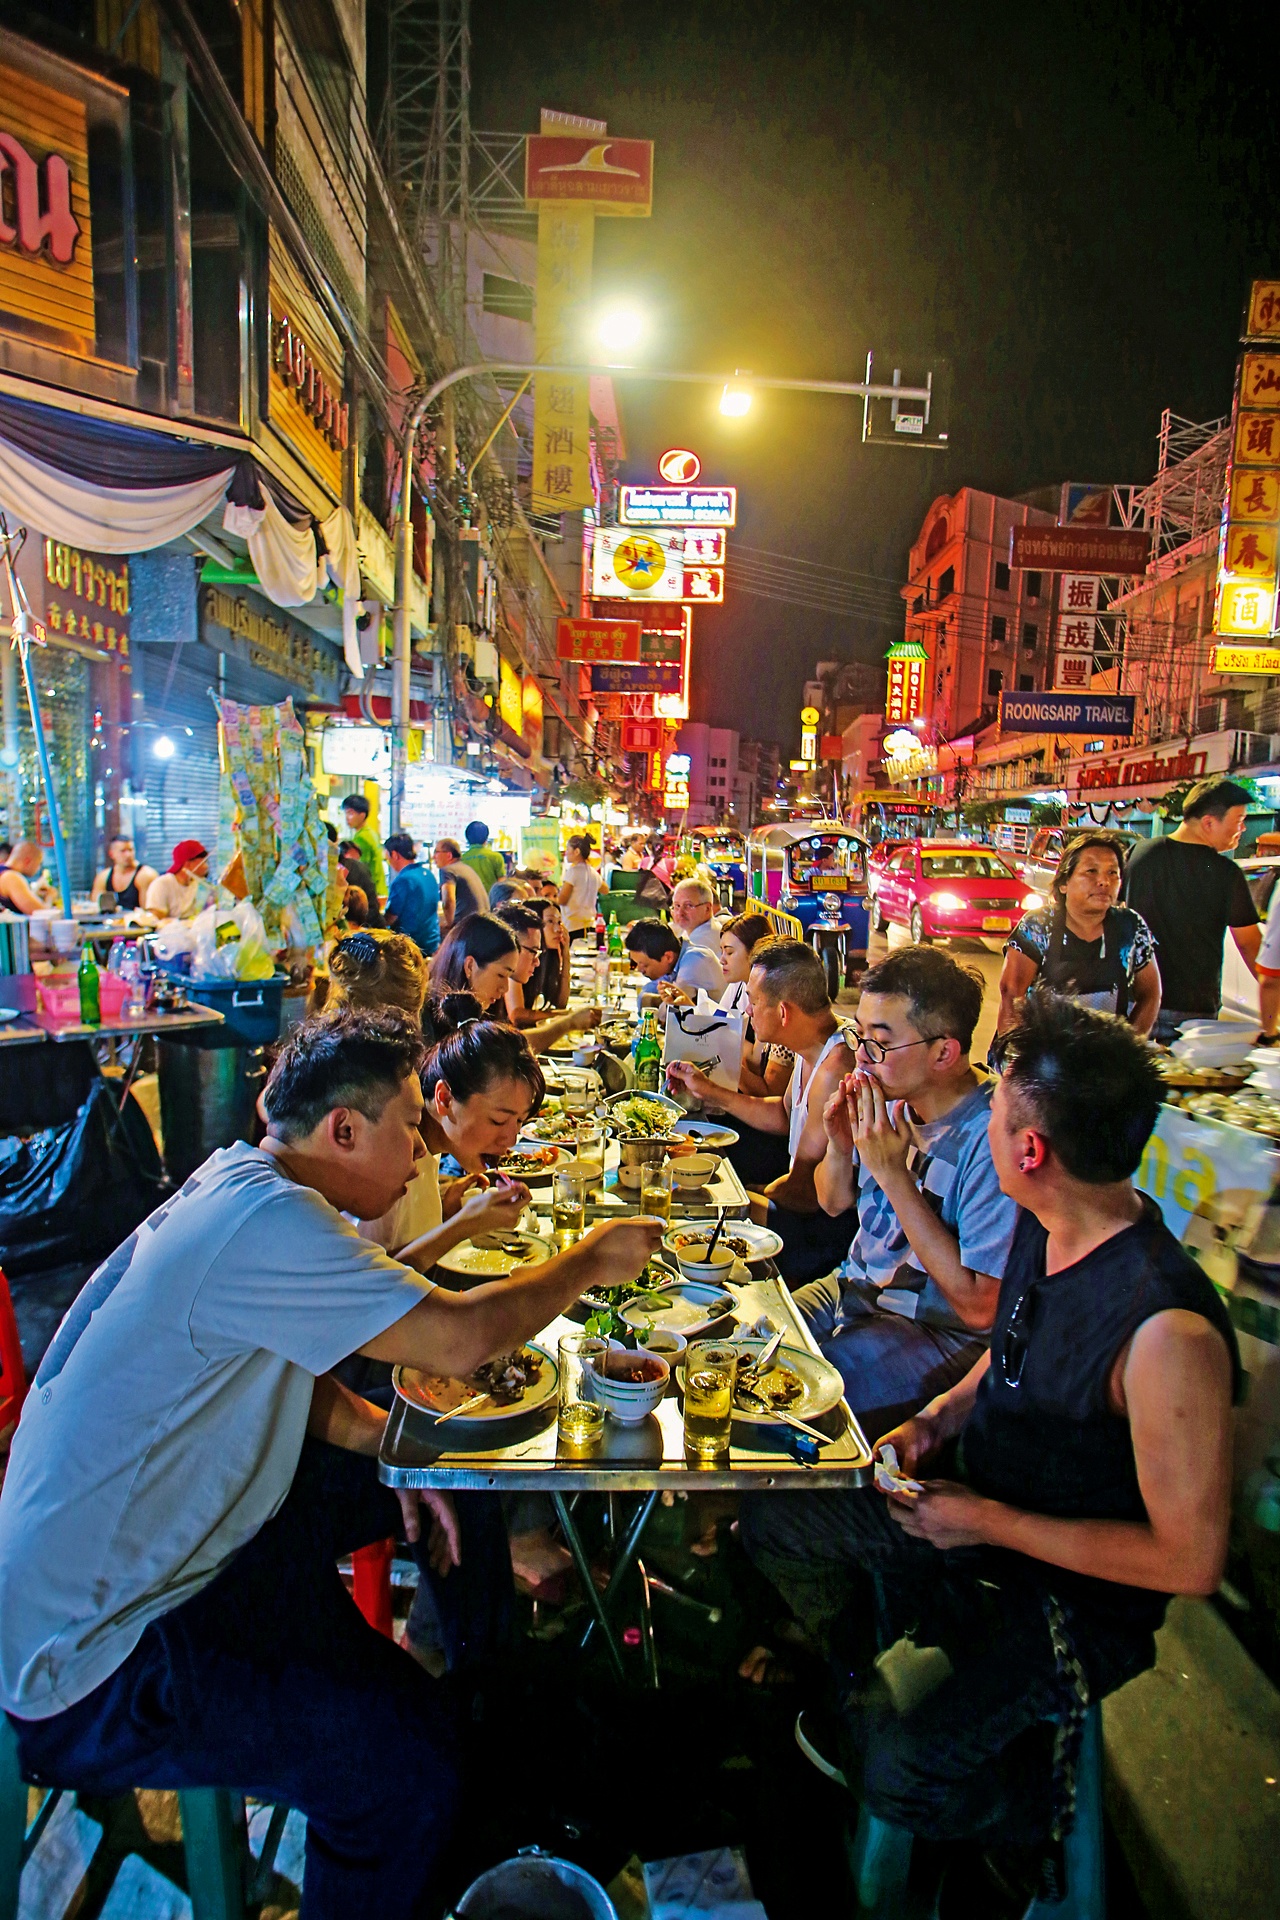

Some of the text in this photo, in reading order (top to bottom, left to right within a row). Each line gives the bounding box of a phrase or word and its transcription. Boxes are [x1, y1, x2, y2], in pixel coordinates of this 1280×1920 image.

[1060, 580, 1094, 686] 振成豐
[610, 683, 663, 691] SEAFOOD
[910, 662, 921, 721] HOTEL
[1005, 703, 1130, 723] ROONGSARP TRAVEL
